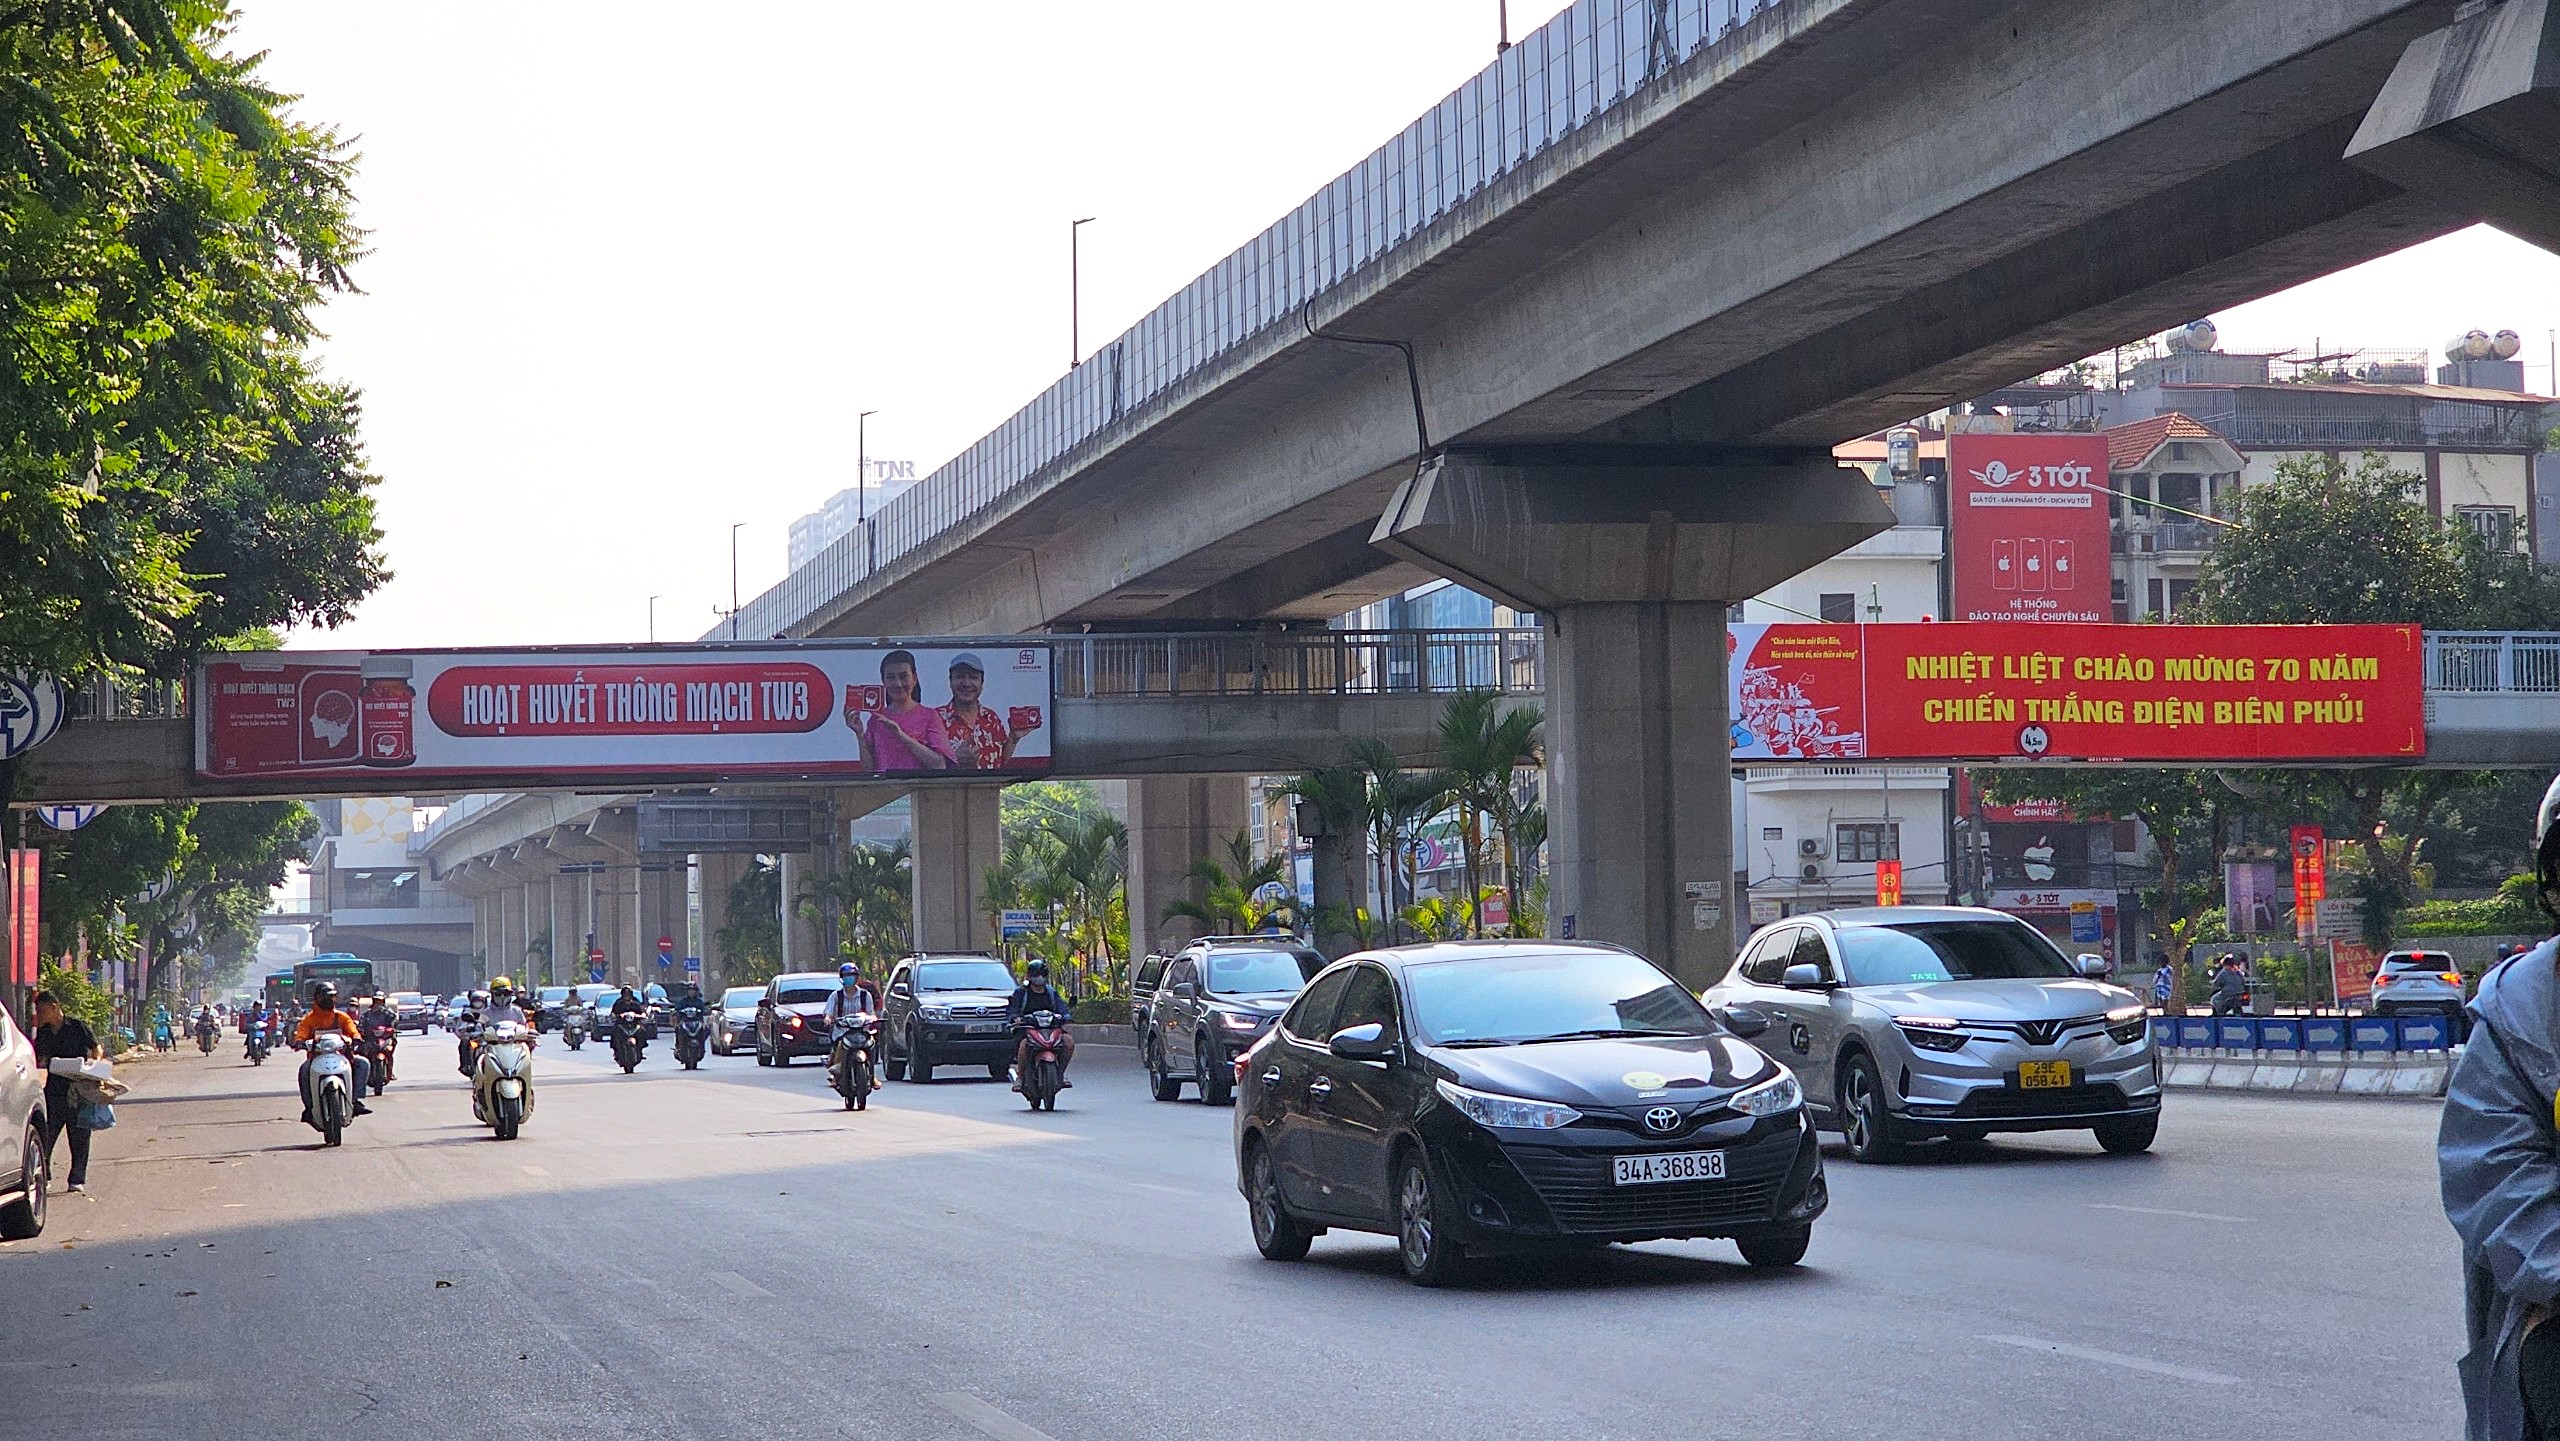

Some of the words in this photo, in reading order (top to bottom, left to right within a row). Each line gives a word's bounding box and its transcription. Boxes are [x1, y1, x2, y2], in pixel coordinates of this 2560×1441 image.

[874, 460, 915, 478] TNR
[2028, 466, 2042, 487] 3
[2044, 459, 2092, 487] TỐT
[2010, 598, 2022, 611] HỆ
[2024, 597, 2057, 609] THỐNG
[1969, 611, 1990, 621] ĐÀO
[1992, 612, 2011, 622] TẠO
[2013, 609, 2040, 621] NGHỀ
[2042, 611, 2079, 622] CHUYÊN
[2080, 611, 2099, 622] SÂU
[1907, 651, 1994, 684] NHIỆT
[2003, 651, 2064, 684] LIỆT
[2074, 653, 2154, 681] CHÀO
[2164, 654, 2255, 681] MỪNG
[2263, 658, 2300, 681] 70
[2309, 653, 2378, 681] NĂM
[276, 698, 295, 708] TW3
[463, 684, 521, 734] HOẠT
[529, 670, 597, 724] HUYẾT
[605, 675, 678, 723] THÔNG
[686, 681, 753, 731] MẠCH
[760, 681, 809, 721] TW3
[1924, 691, 2015, 723] CHIẾN
[2023, 691, 2124, 724] THẮNG
[2133, 696, 2204, 729] ĐIỆN
[2214, 696, 2284, 724] BIÊN
[2294, 693, 2364, 724] PHỦ!
[2013, 807, 2039, 816] CHÍNH
[2033, 1062, 2056, 1074] 29E
[1618, 1154, 1722, 1181] 34A-368.98
